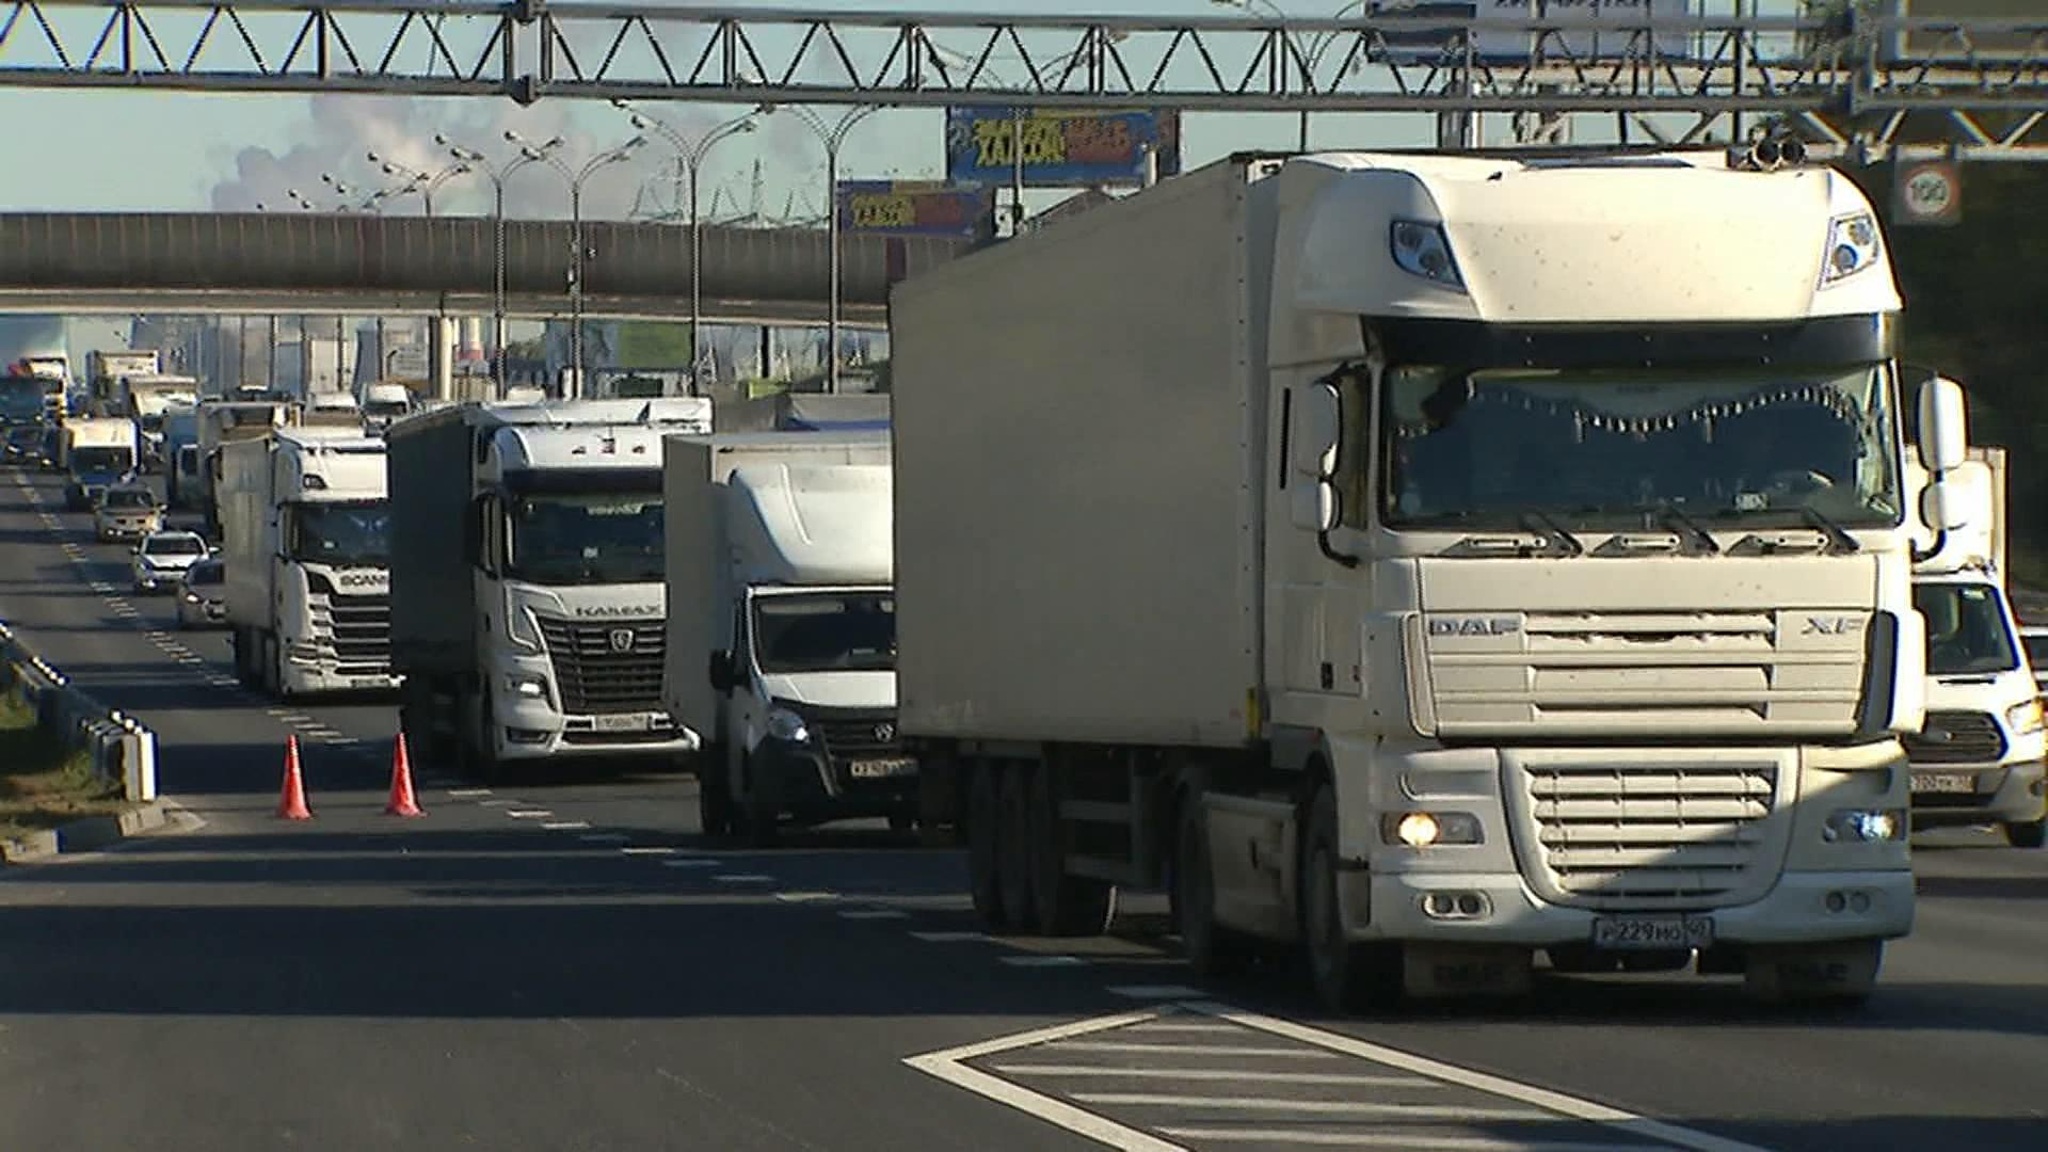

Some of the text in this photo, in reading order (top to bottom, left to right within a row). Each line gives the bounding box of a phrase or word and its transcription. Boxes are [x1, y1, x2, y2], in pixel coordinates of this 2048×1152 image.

[1909, 178, 1948, 202] 100
[341, 574, 387, 586] SCAN
[1429, 618, 1521, 636] DAF
[1800, 616, 1866, 635] XF
